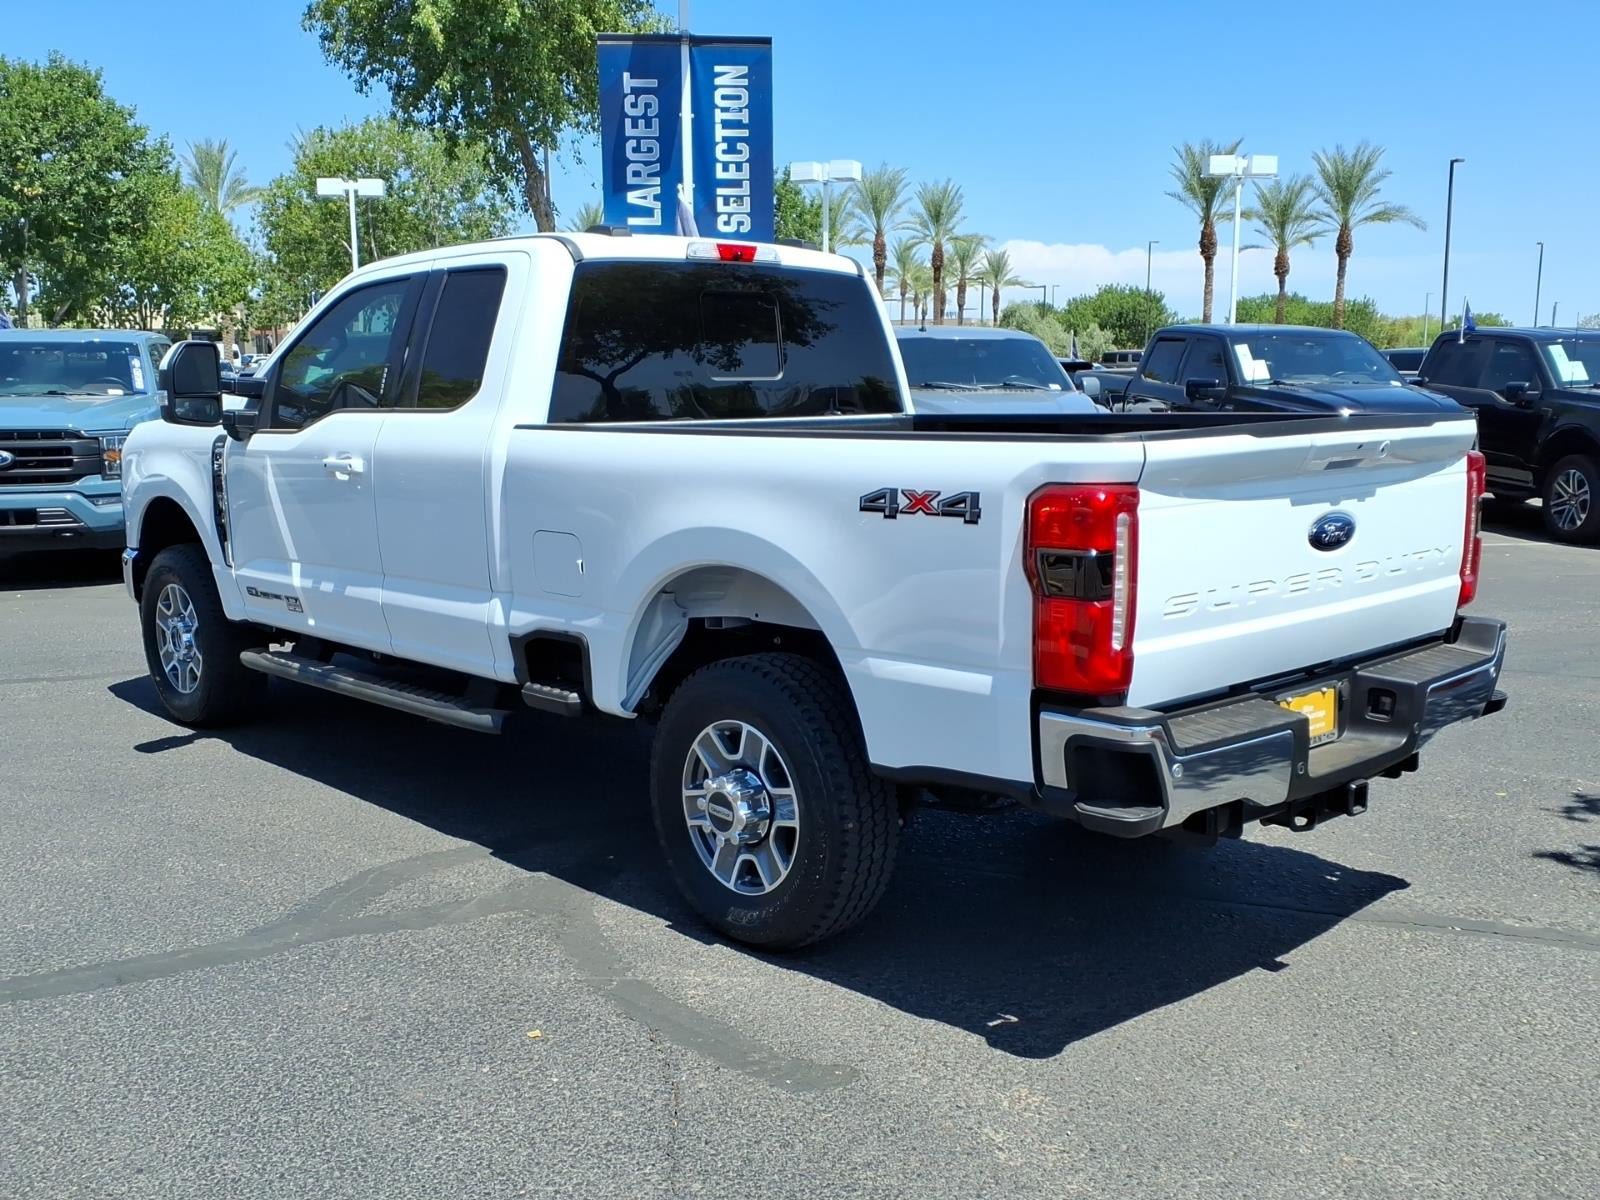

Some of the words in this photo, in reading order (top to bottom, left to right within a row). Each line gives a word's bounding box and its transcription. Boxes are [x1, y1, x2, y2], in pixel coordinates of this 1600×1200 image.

[623, 72, 662, 226] LARGEST
[713, 65, 751, 233] SELECTION
[1163, 568, 1343, 620] SUPER
[1354, 544, 1452, 584] DUTY
